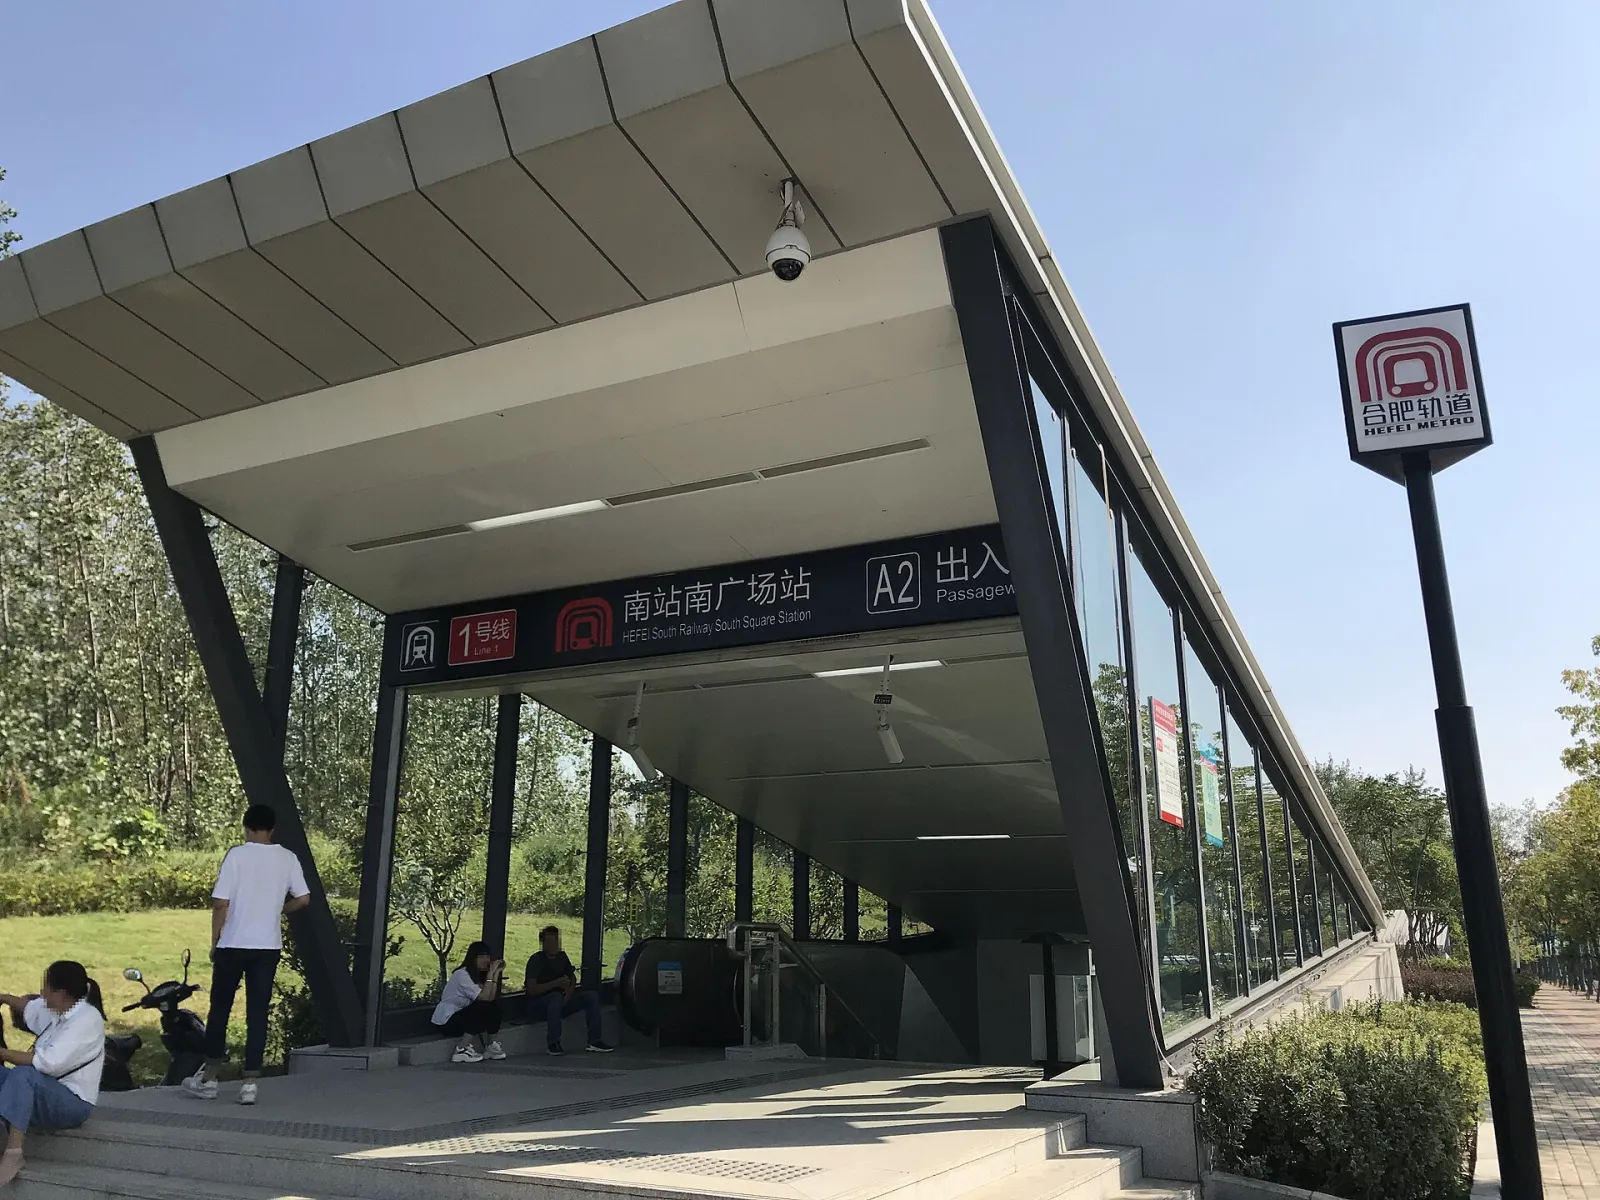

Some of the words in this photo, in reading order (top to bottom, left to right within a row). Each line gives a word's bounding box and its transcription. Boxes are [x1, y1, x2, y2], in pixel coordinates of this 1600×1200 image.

[1362, 393, 1473, 427] 合肥轨道
[1364, 424, 1412, 436] HEFEI
[1418, 416, 1475, 430] METRO
[936, 541, 1010, 583] 出入
[623, 566, 812, 624] 南站南广场站
[873, 560, 914, 606] A2
[459, 618, 510, 657] 1号线
[623, 627, 650, 643] HEFEI
[652, 621, 677, 639] South
[679, 617, 713, 636] Railway
[715, 613, 741, 632] South
[743, 608, 776, 629] Square
[778, 608, 812, 624] Station
[474, 646, 491, 655] Line
